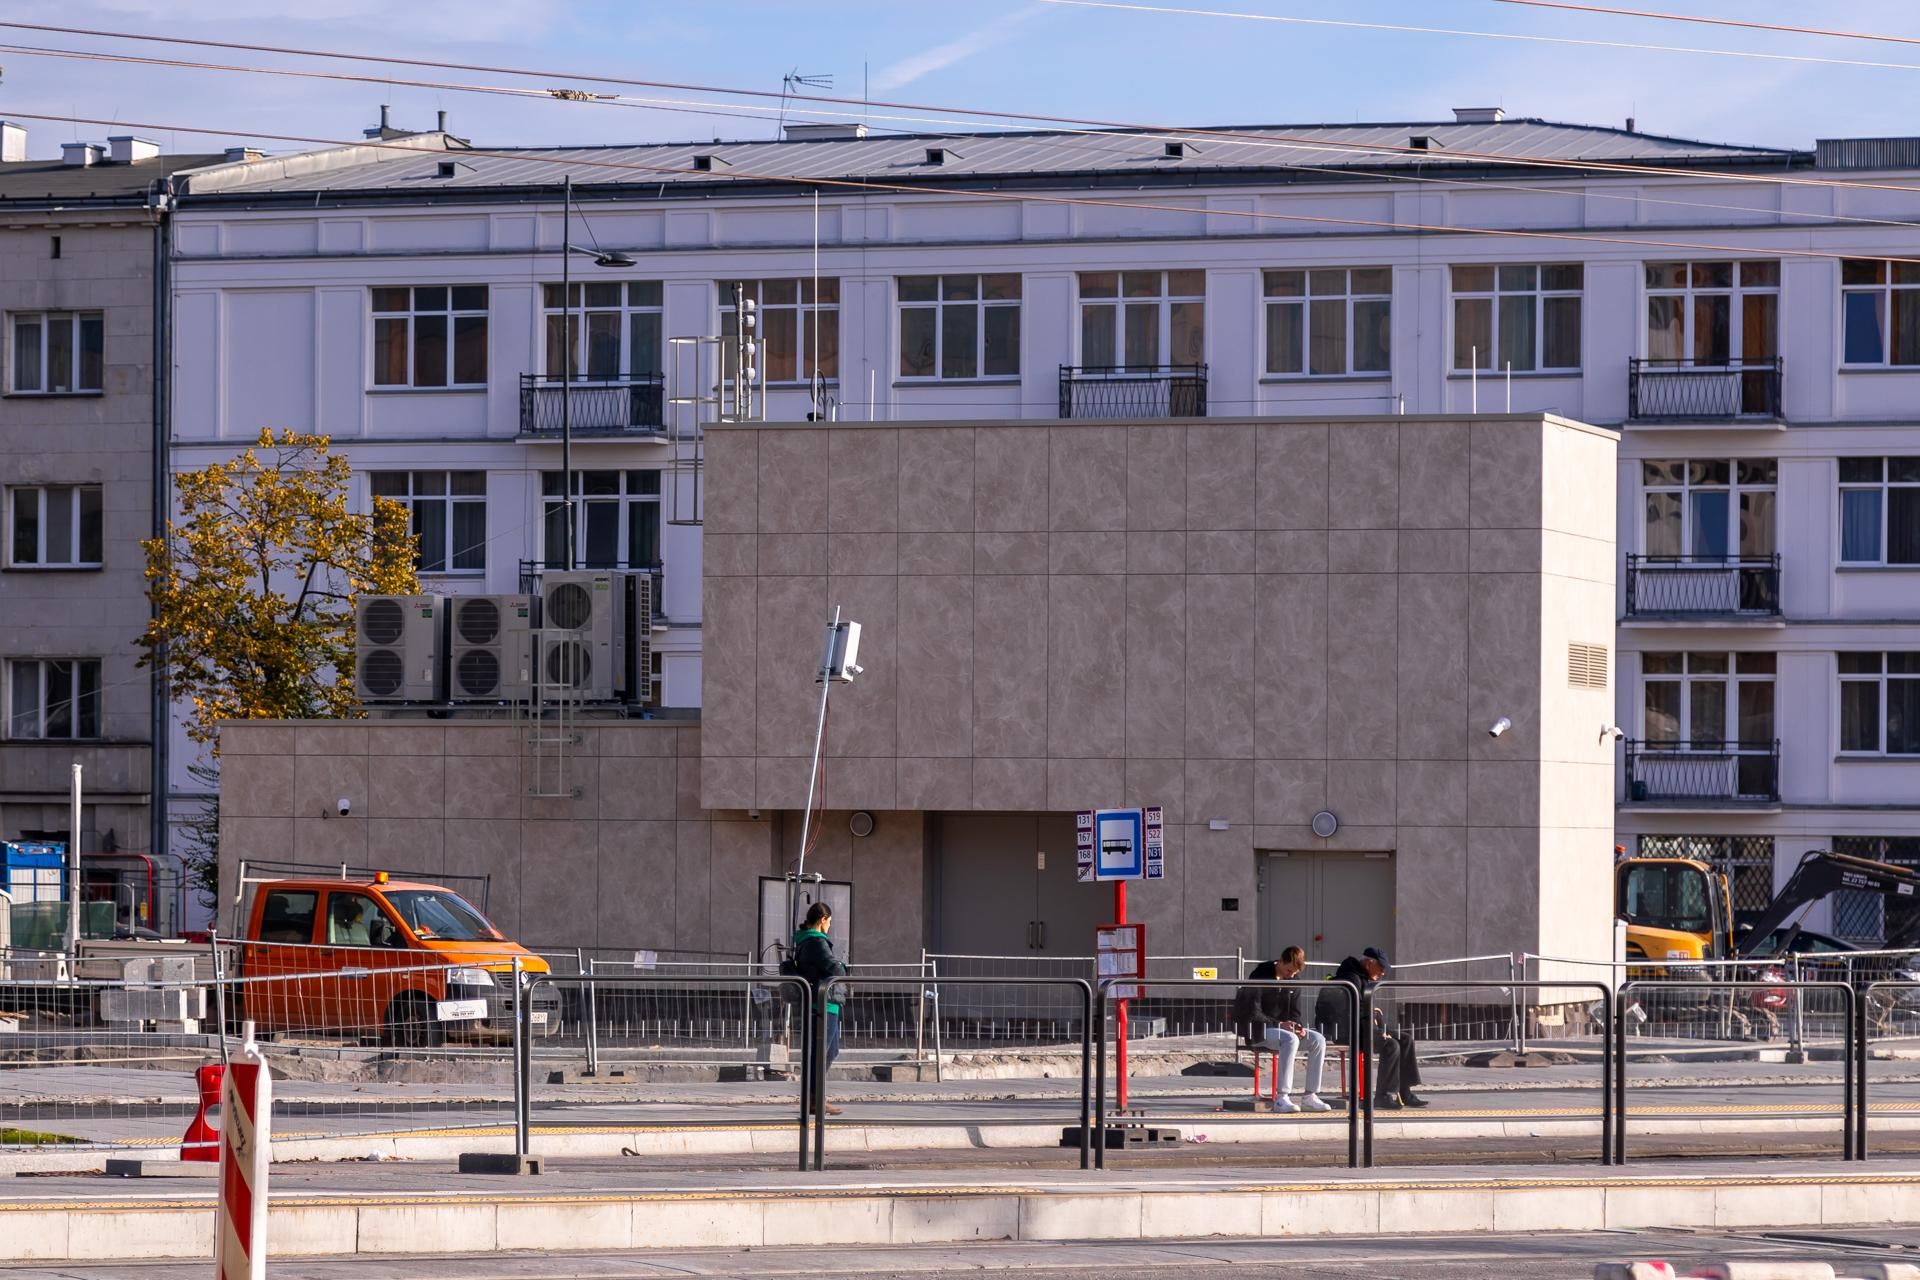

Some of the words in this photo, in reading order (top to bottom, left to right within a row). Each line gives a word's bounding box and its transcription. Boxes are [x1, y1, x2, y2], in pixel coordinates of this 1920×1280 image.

[1078, 815, 1090, 825] 131
[1148, 812, 1161, 821] 519
[1078, 833, 1091, 842] 167
[1148, 830, 1161, 839] 522
[1079, 850, 1091, 859] 168
[1148, 847, 1161, 857] N31
[1148, 865, 1162, 875] N81
